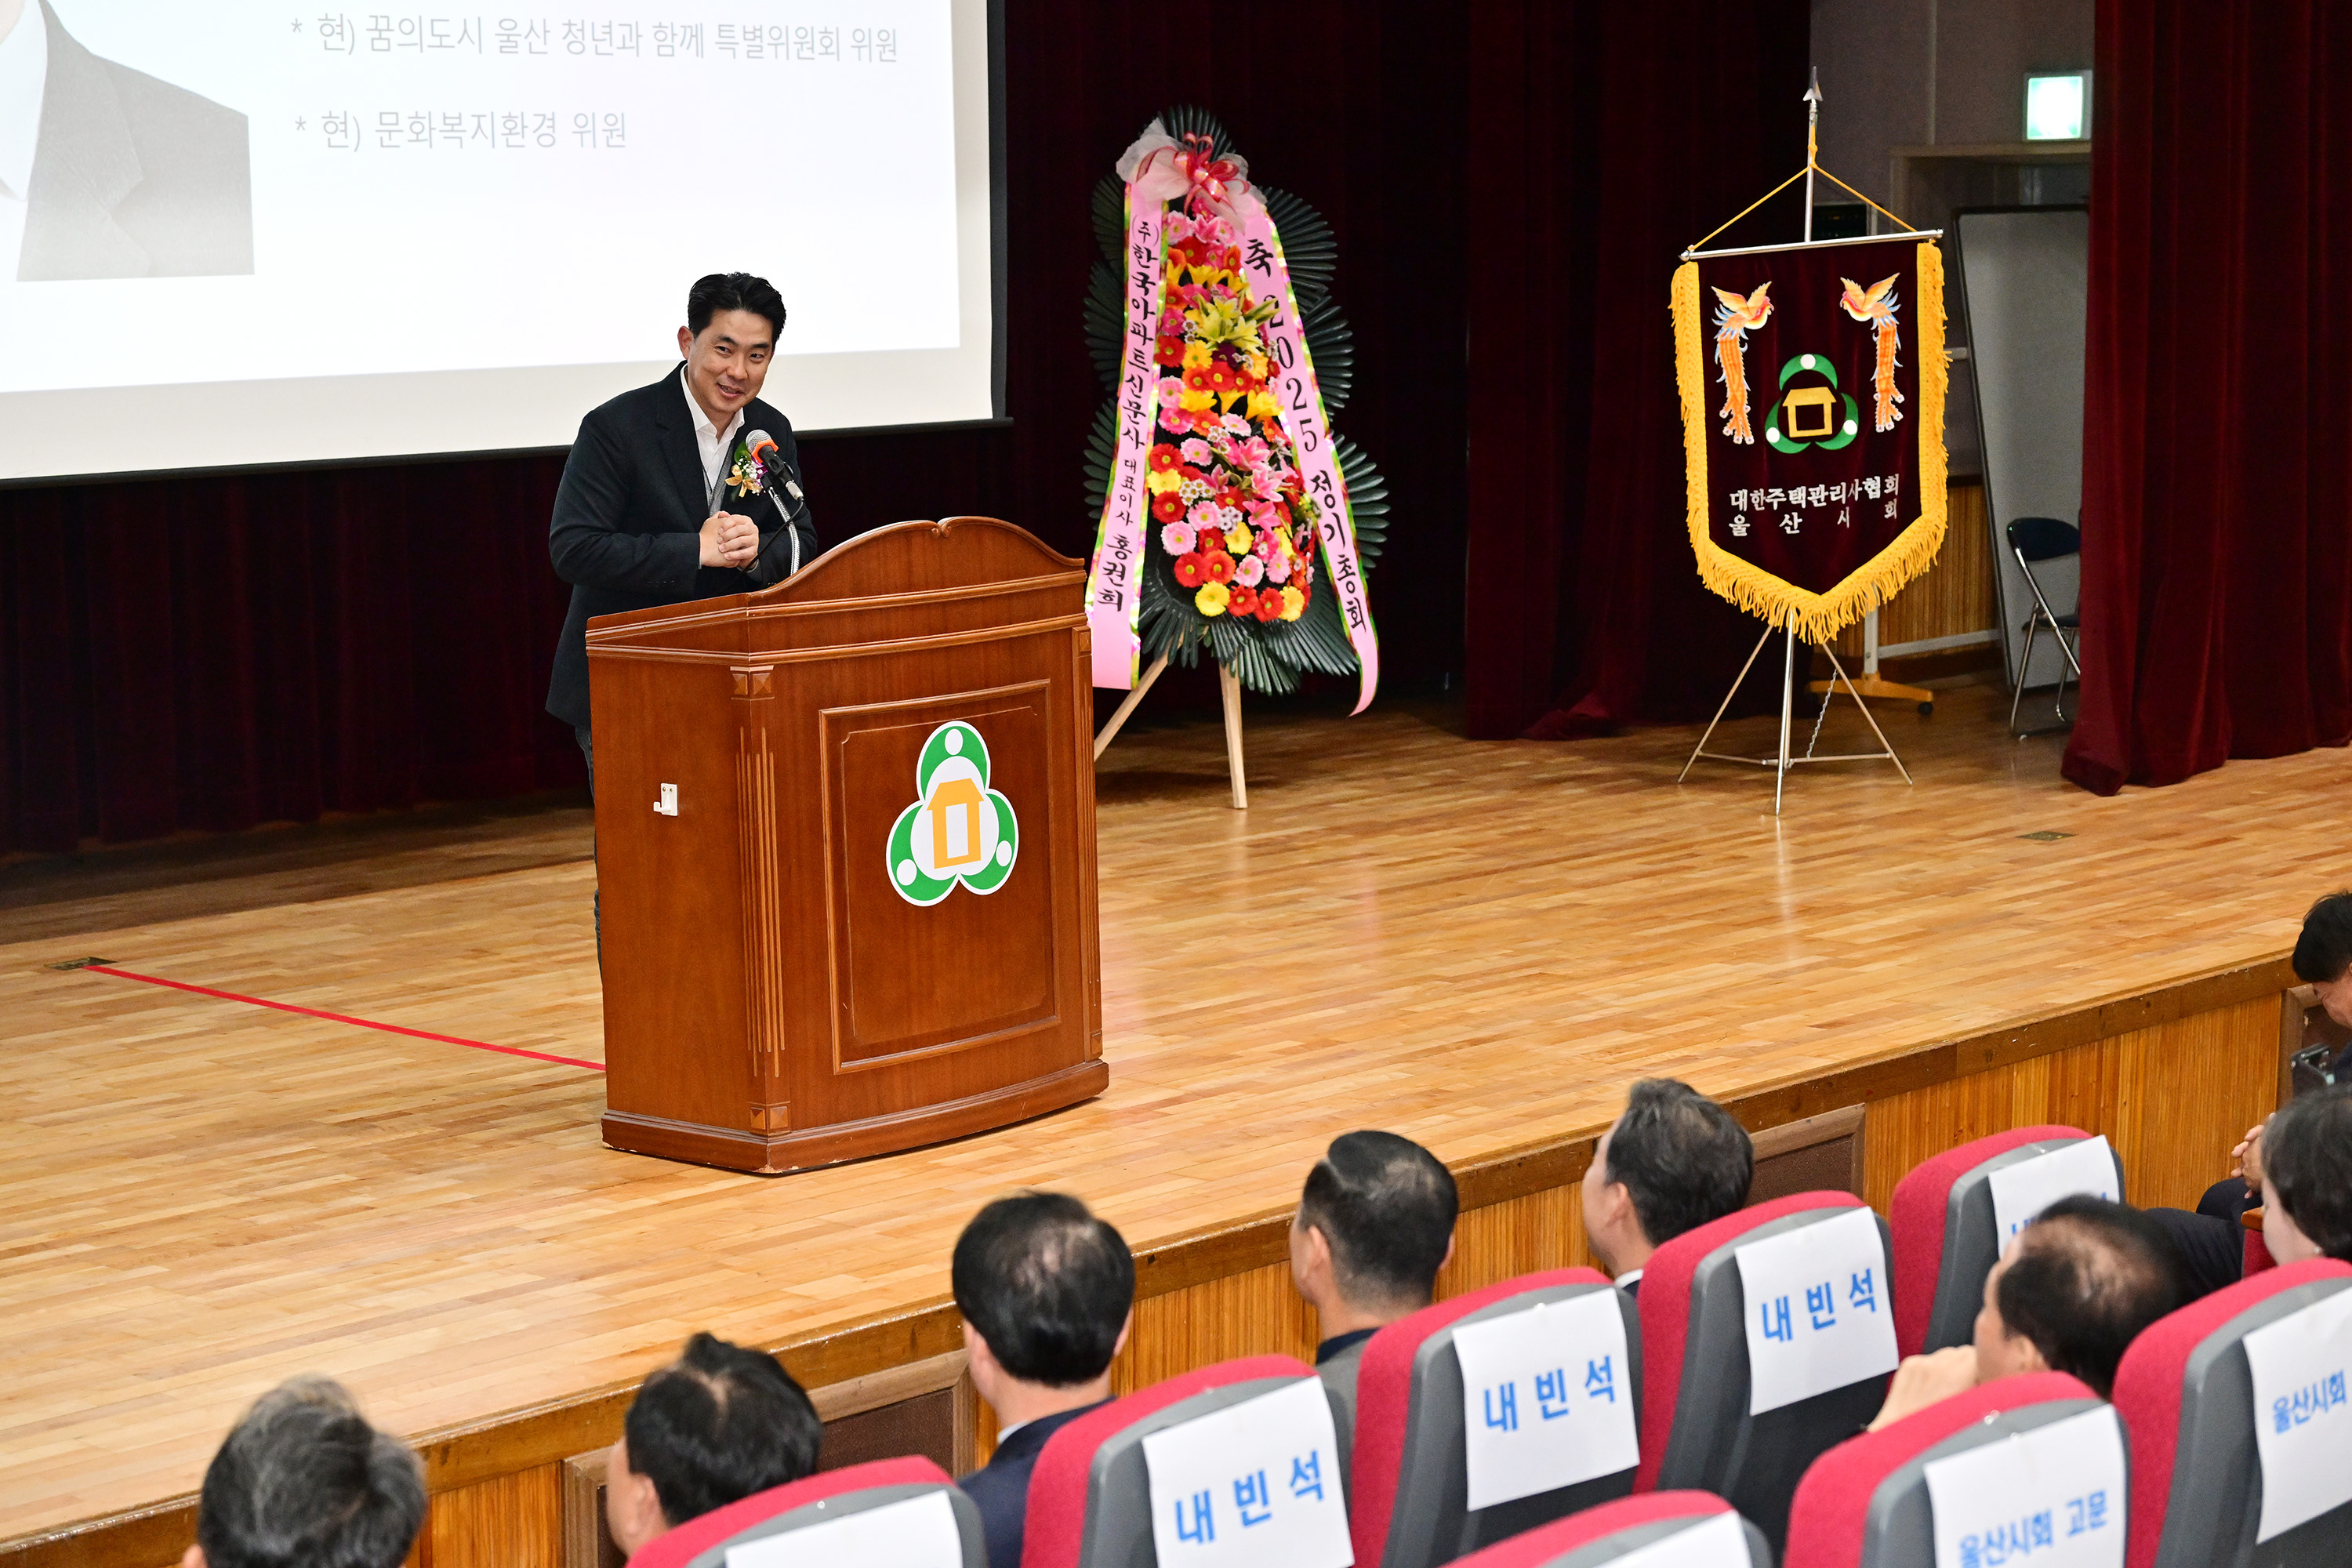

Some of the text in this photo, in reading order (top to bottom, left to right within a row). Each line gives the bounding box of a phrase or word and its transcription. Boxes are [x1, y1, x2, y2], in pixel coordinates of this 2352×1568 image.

[318, 13, 898, 63] 현) 꿈의도시 울산 청년과 함께 특별위원회 위원
[321, 111, 626, 151] 현) 문화복지환경 위원
[1244, 238, 1367, 633] 축 2025 정기총회
[1115, 459, 1137, 527] 대표이사
[1730, 474, 1900, 512] 대한주택관리사협회
[1098, 534, 1133, 612] 홍권희
[2273, 1370, 2347, 1435] 울산시회
[1959, 1490, 2107, 1568] 울산시회 고문
